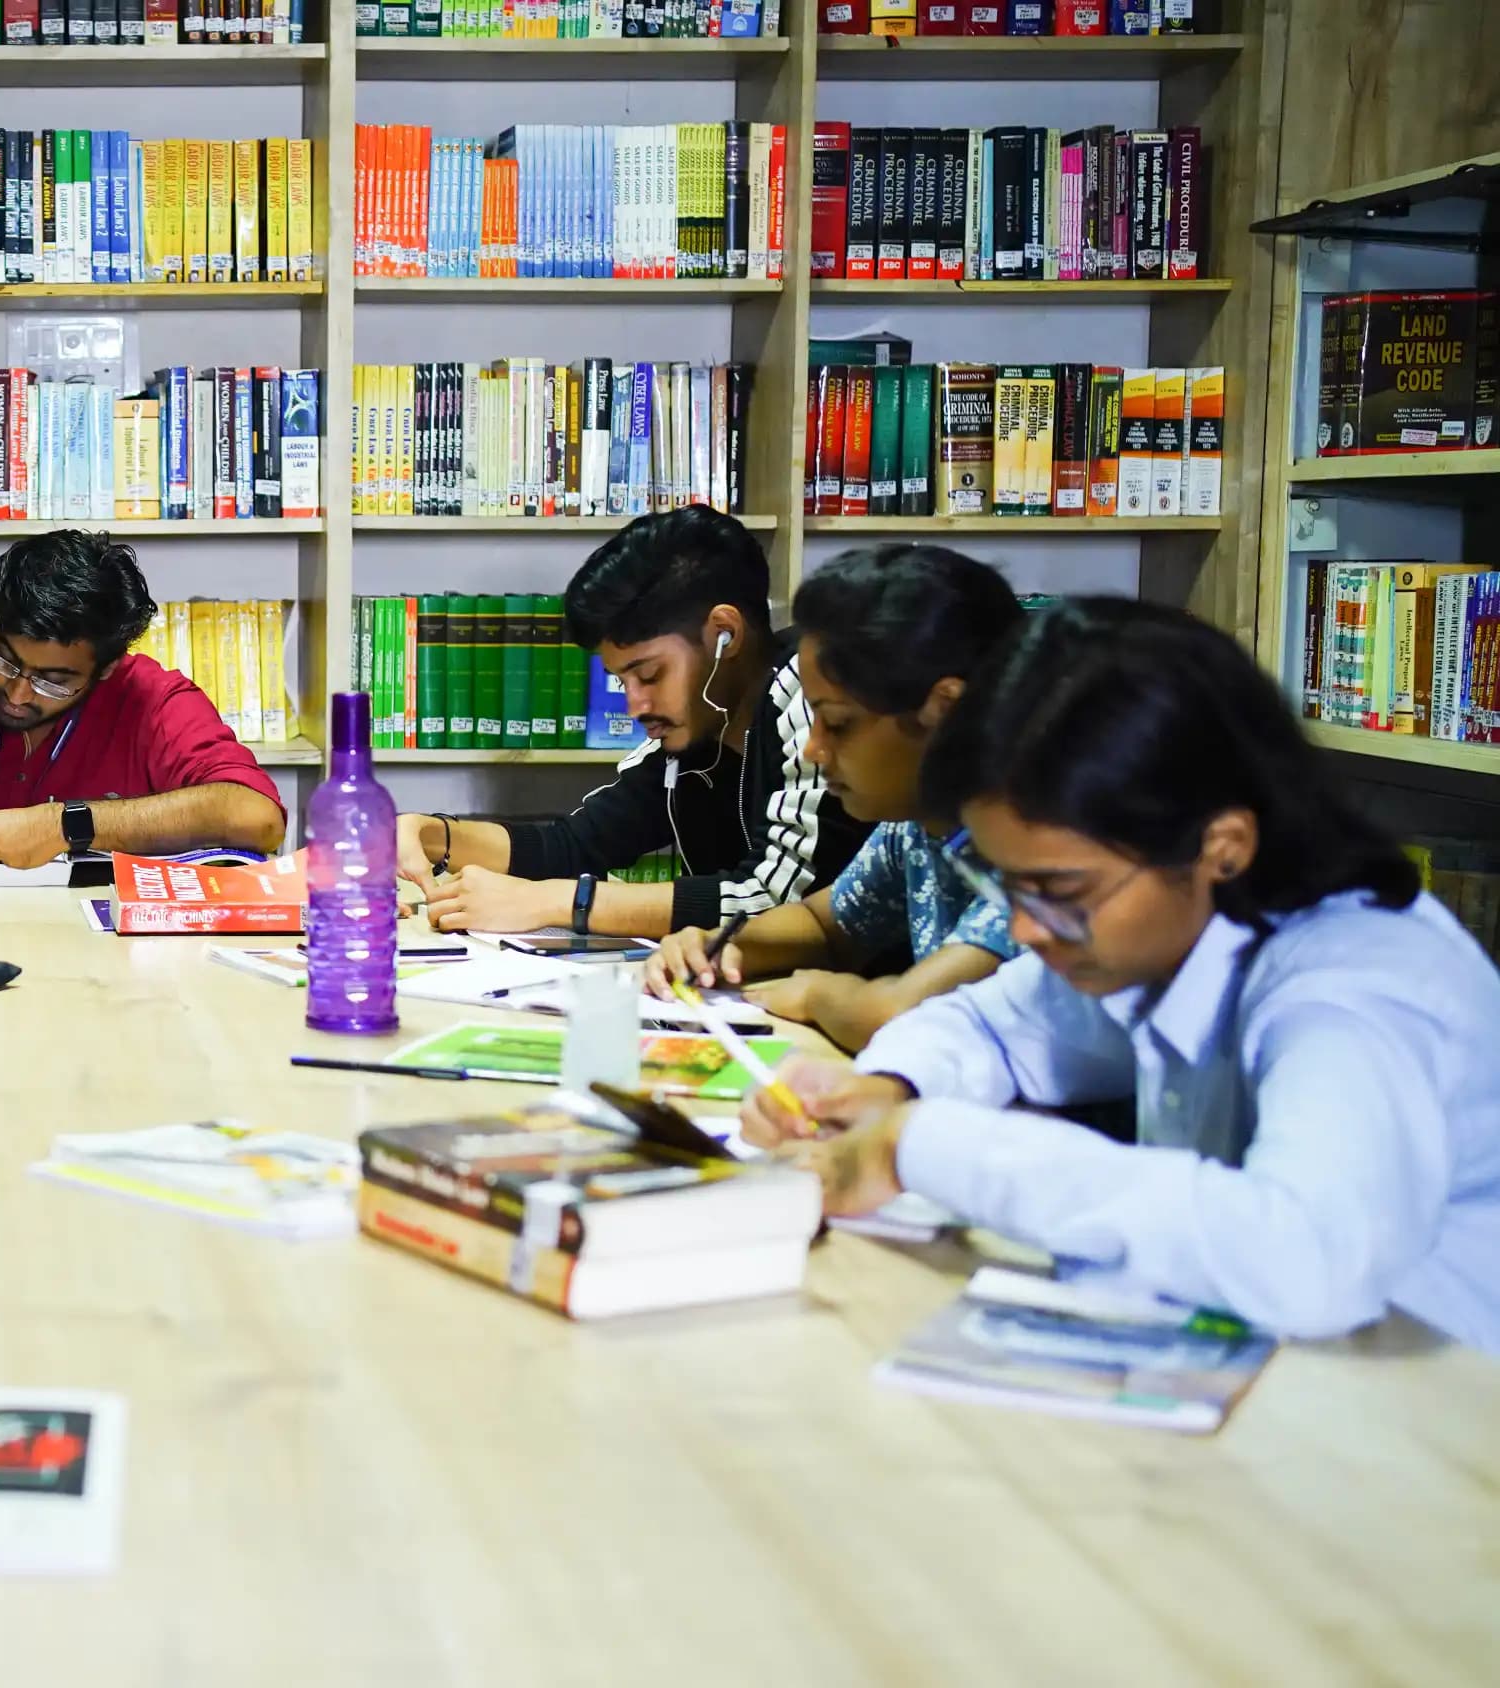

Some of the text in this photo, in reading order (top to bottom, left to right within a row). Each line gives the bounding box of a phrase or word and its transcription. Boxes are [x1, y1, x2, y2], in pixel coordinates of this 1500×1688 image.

[1181, 143, 1191, 177] CIVIL
[6, 178, 18, 233] Labour Laws
[21, 179, 32, 234] Labour Laws
[96, 176, 108, 207] Labour
[114, 176, 127, 208] Labour
[852, 154, 863, 226] PROCEDURE
[864, 159, 875, 221] CRIMINAL
[883, 153, 895, 226] PROCEDURE
[895, 159, 906, 220] CRIMINAL
[913, 153, 924, 226] PROCEDURE
[925, 159, 936, 220] CRIMINAL
[942, 155, 953, 227] PROCEDURE
[954, 160, 964, 222] CRIMINAL
[96, 208, 108, 230] Laws
[114, 209, 126, 230] Laws
[1381, 341, 1463, 365] REVENUE
[1400, 315, 1447, 338] LAND
[221, 381, 230, 421] WOMEN
[598, 370, 609, 411] Press Law
[635, 372, 647, 437] CYBER LAWS
[827, 378, 835, 425] CRIMINAL
[1396, 369, 1443, 392] CODE
[854, 380, 864, 452] CRIMINAL LAW
[944, 402, 993, 415] CRIMINAL
[999, 384, 1010, 441] PROCEDURE
[1010, 385, 1021, 432] CRIMINAL
[1027, 385, 1039, 442] PROCEDURE
[1038, 385, 1049, 433] CRIMINAL
[1402, 609, 1413, 692] Intellectual Property
[1435, 618, 1445, 675] INTELLECTUAL
[1448, 616, 1459, 674] INTELLECTUAL
[132, 864, 169, 899] ELECTRIC
[166, 865, 206, 901] MACHINES
